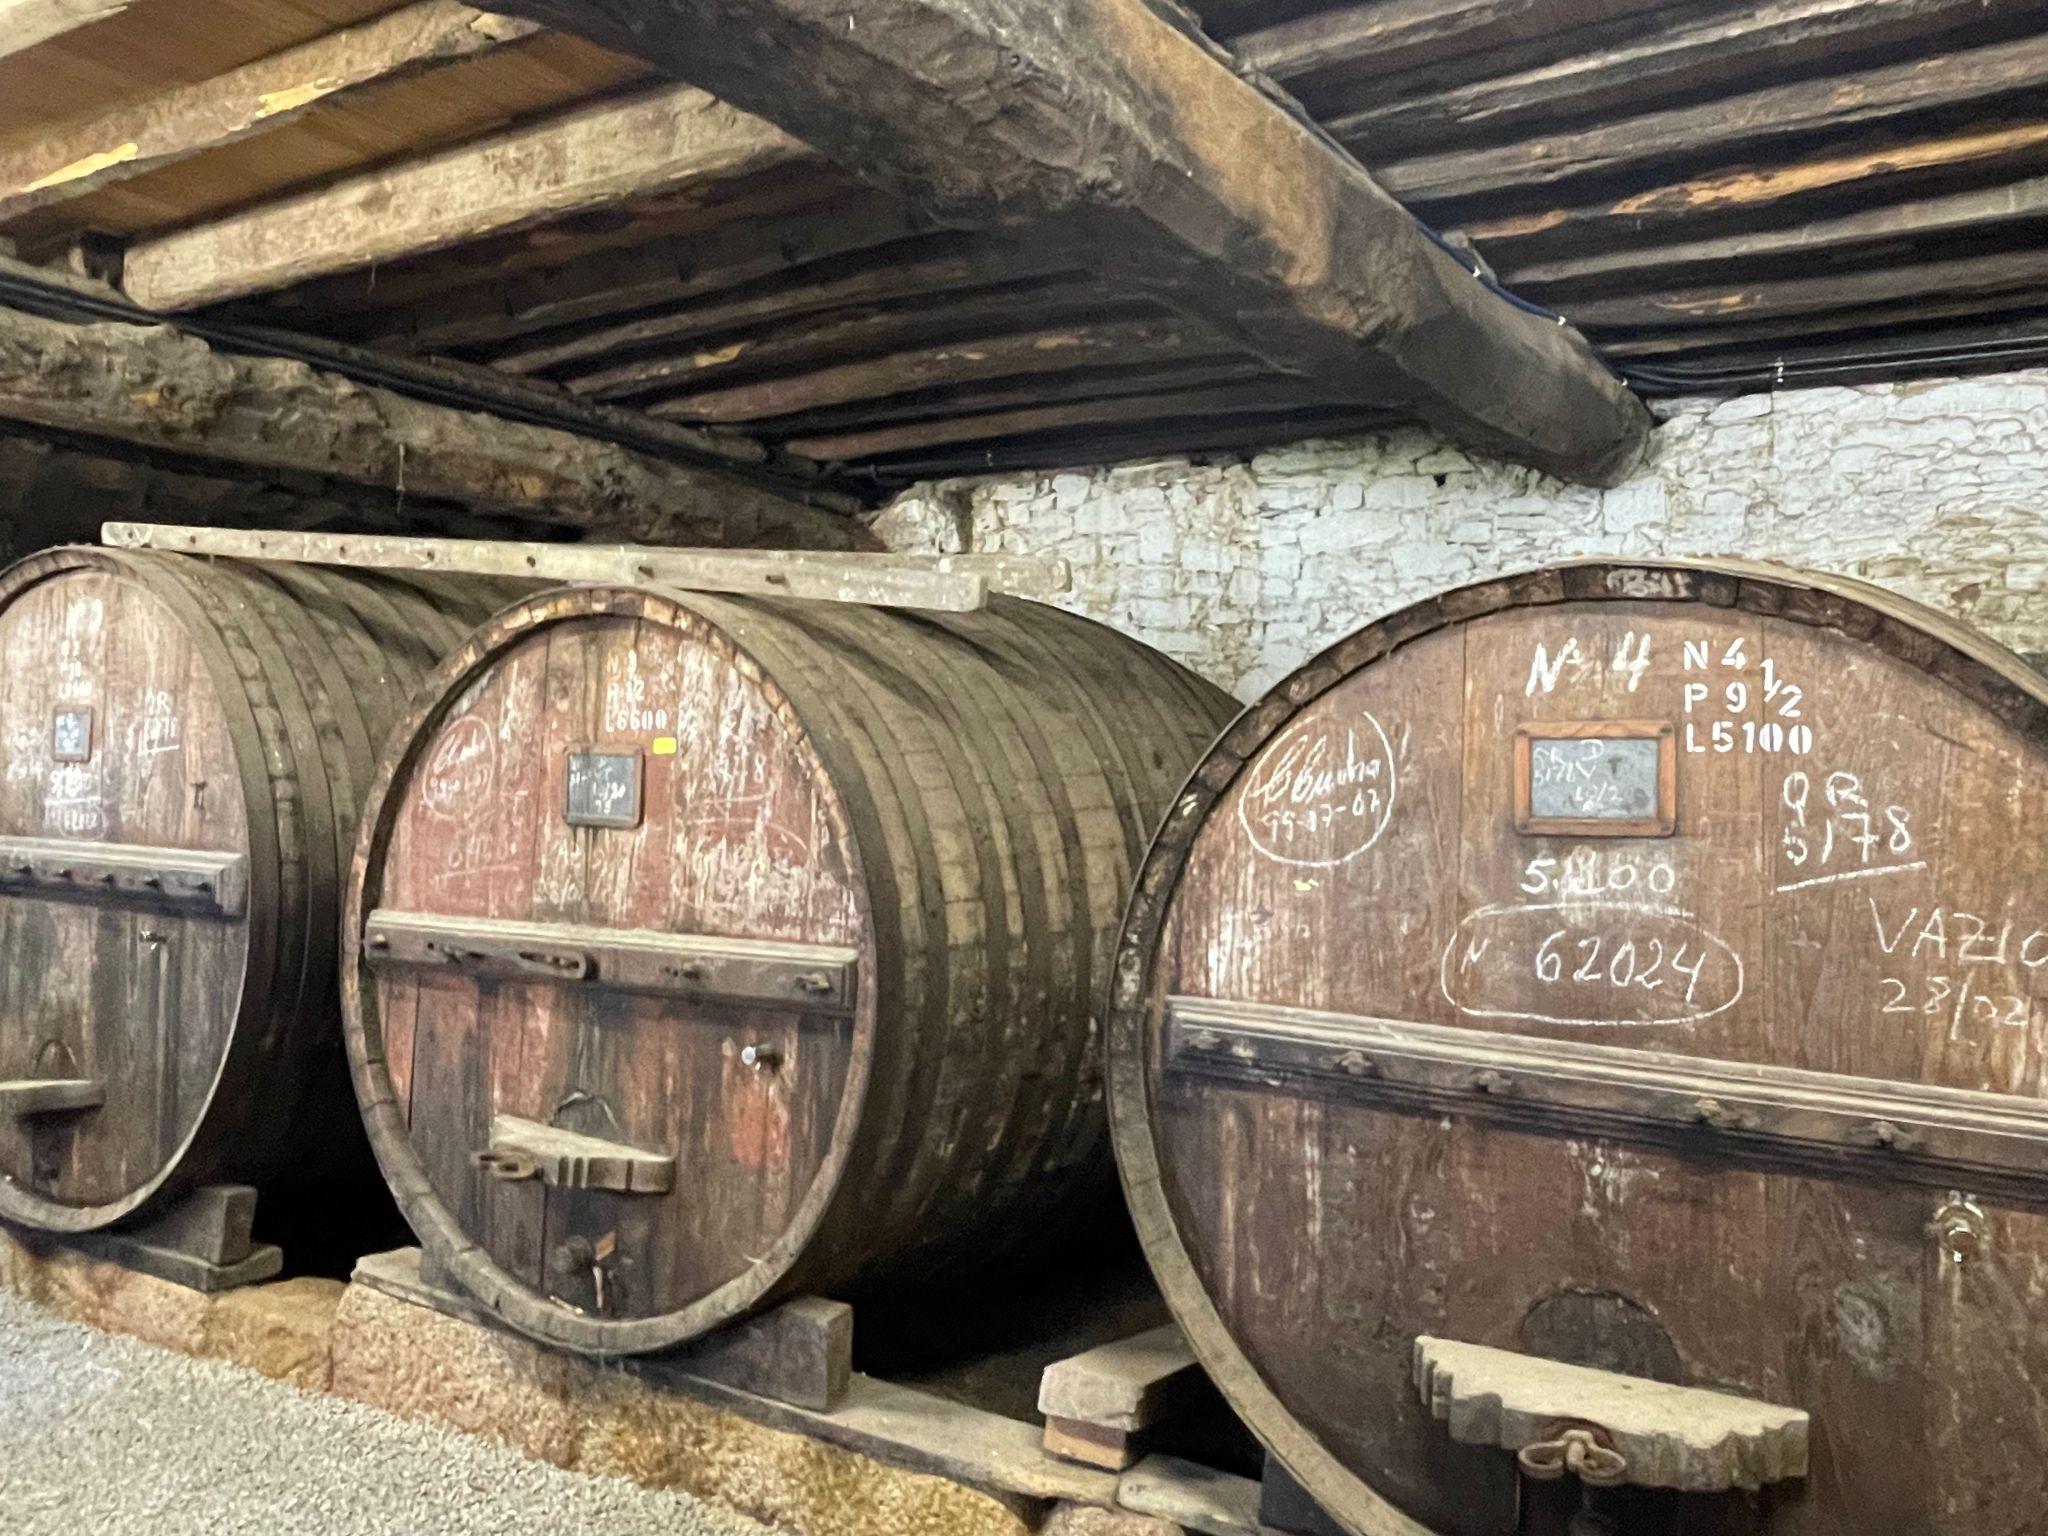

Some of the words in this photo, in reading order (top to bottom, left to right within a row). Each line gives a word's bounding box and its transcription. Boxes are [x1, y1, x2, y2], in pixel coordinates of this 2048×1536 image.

[1612, 631, 1651, 692] 4
[1684, 641, 1708, 670] N
[1721, 637, 1746, 669] 4
[1685, 683, 1708, 713] P
[605, 708, 668, 732] L6600
[1686, 721, 1812, 755] L5100
[1783, 805, 1911, 866] 5178
[1535, 930, 1707, 1003] 62024
